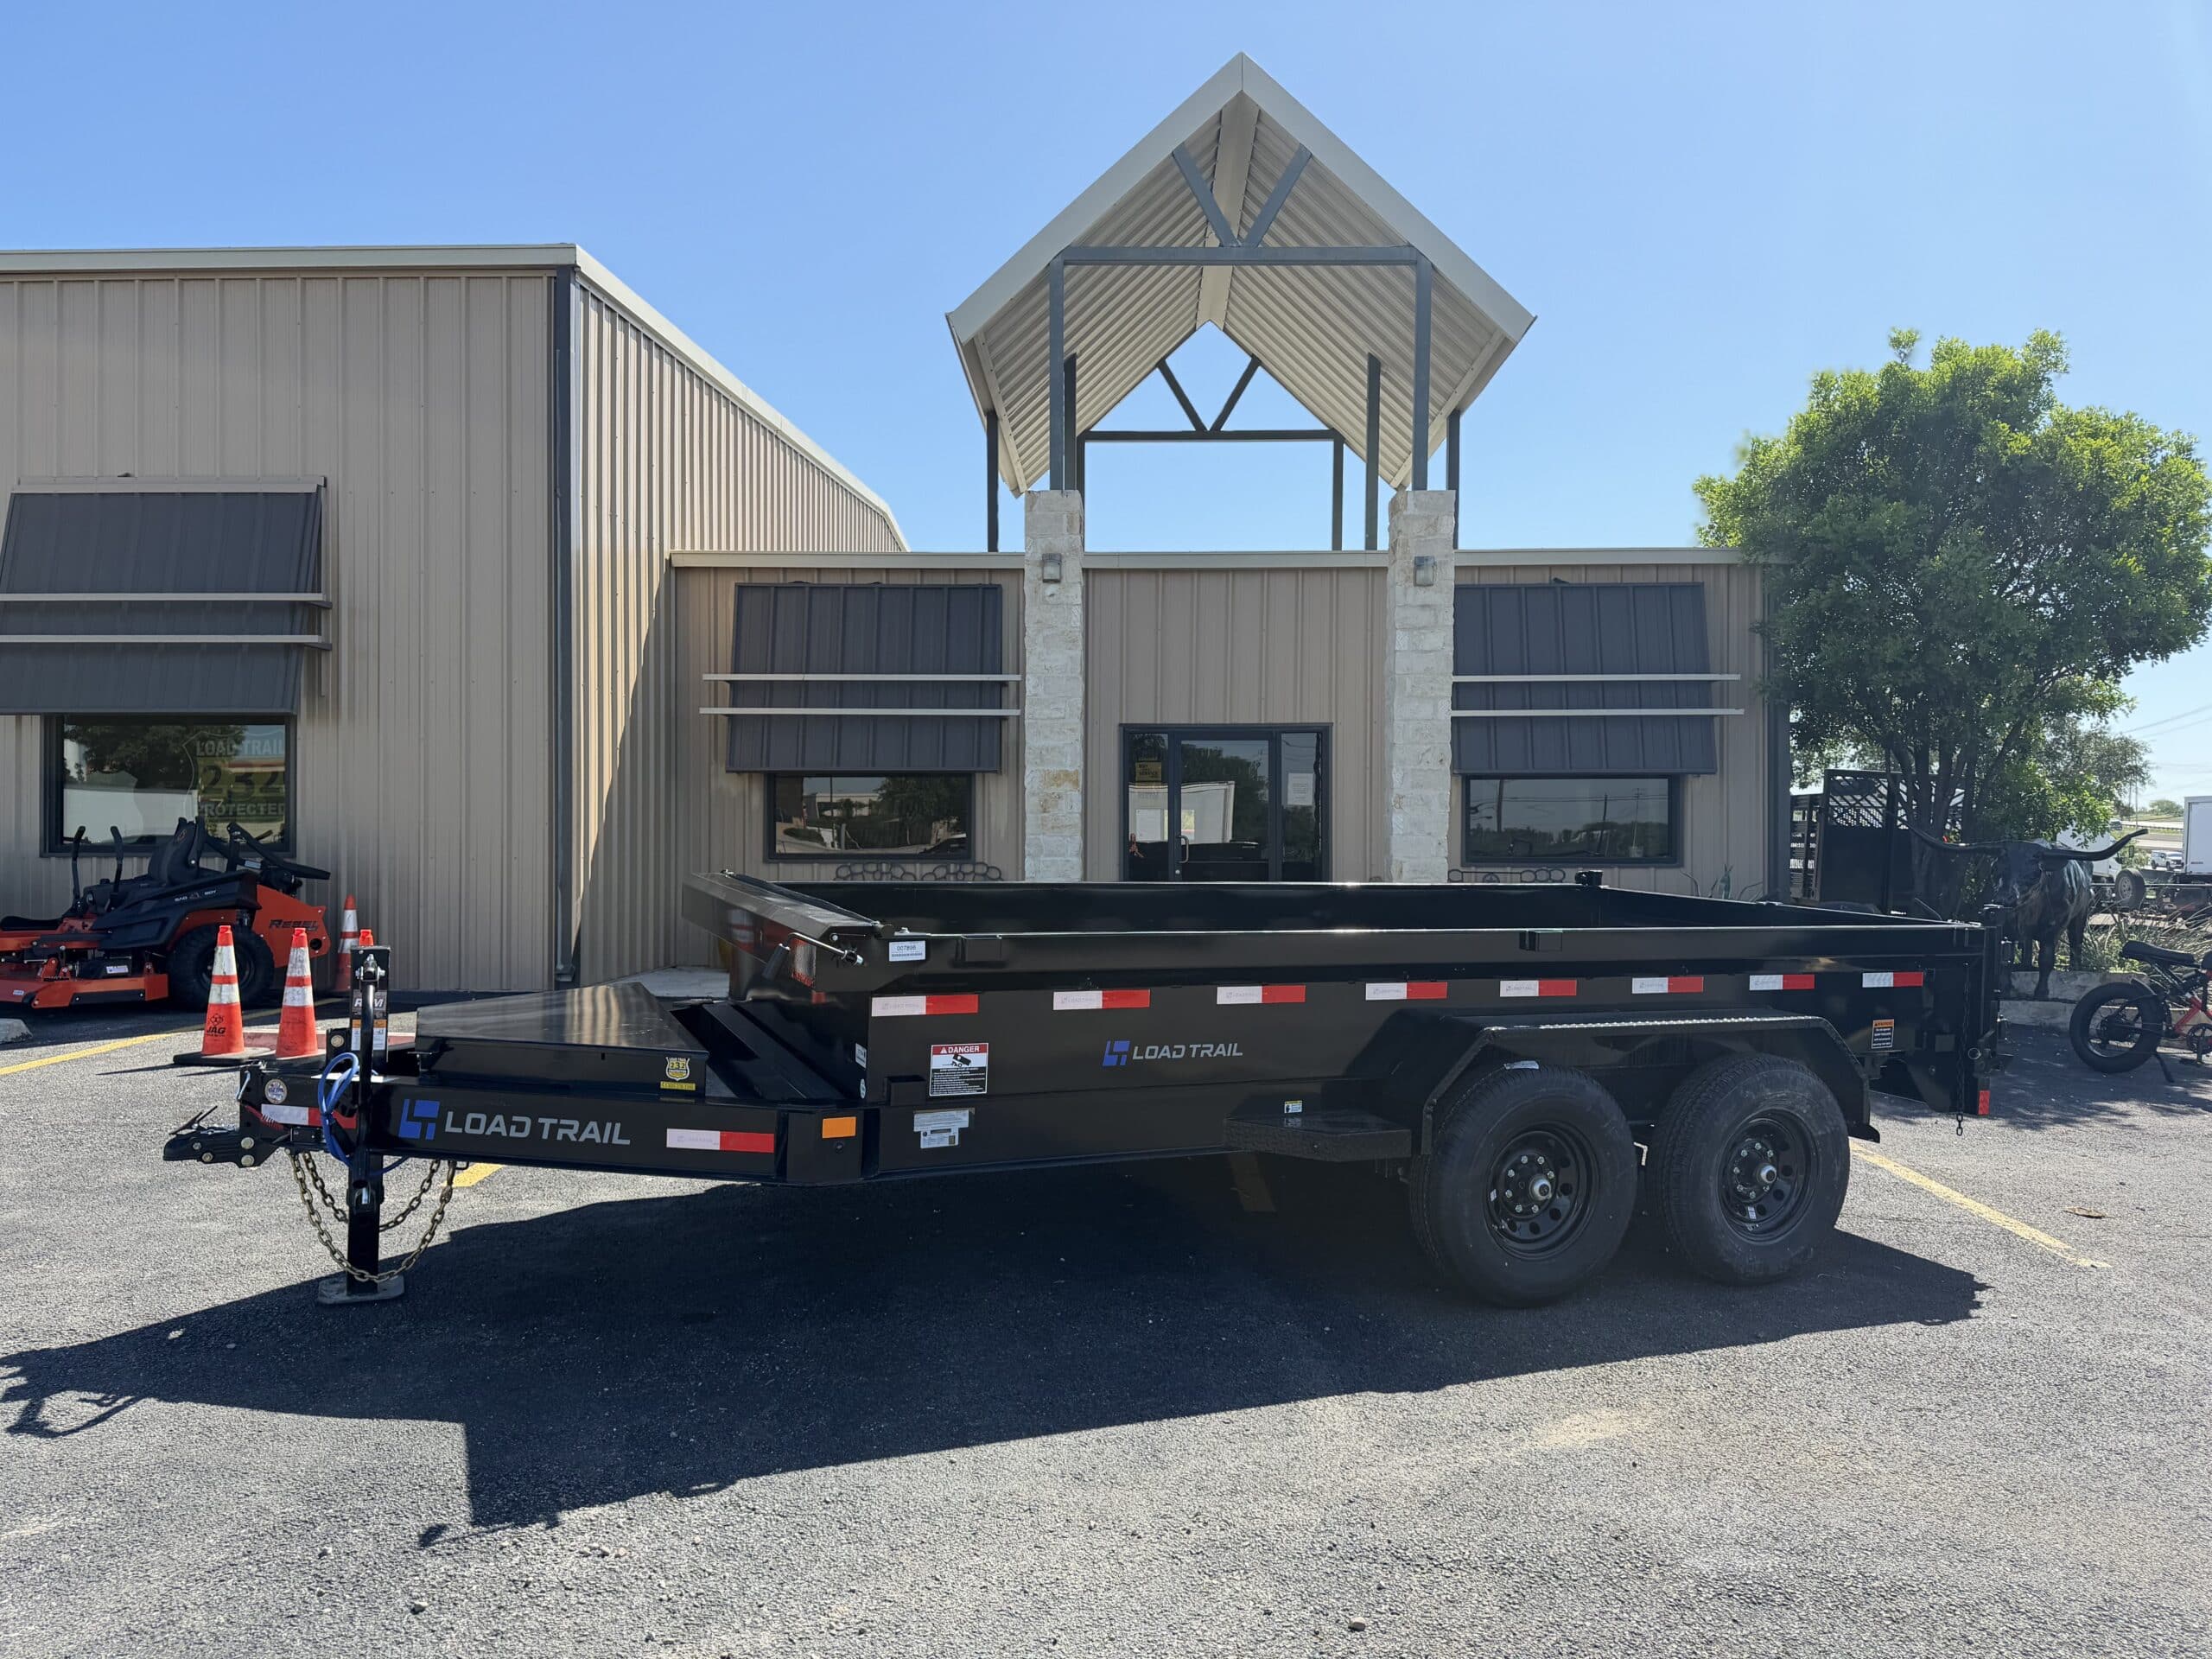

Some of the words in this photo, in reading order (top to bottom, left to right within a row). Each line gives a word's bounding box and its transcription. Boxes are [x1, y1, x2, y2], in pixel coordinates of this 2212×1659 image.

[195, 740, 235, 756] LOAD
[354, 998, 384, 1007] RM
[207, 1026, 226, 1034] JAG
[1132, 1045, 1185, 1059] LOAD
[1189, 1043, 1243, 1058] TRAIL
[445, 1111, 531, 1138] LOAD
[537, 1117, 631, 1145] TRAIL
